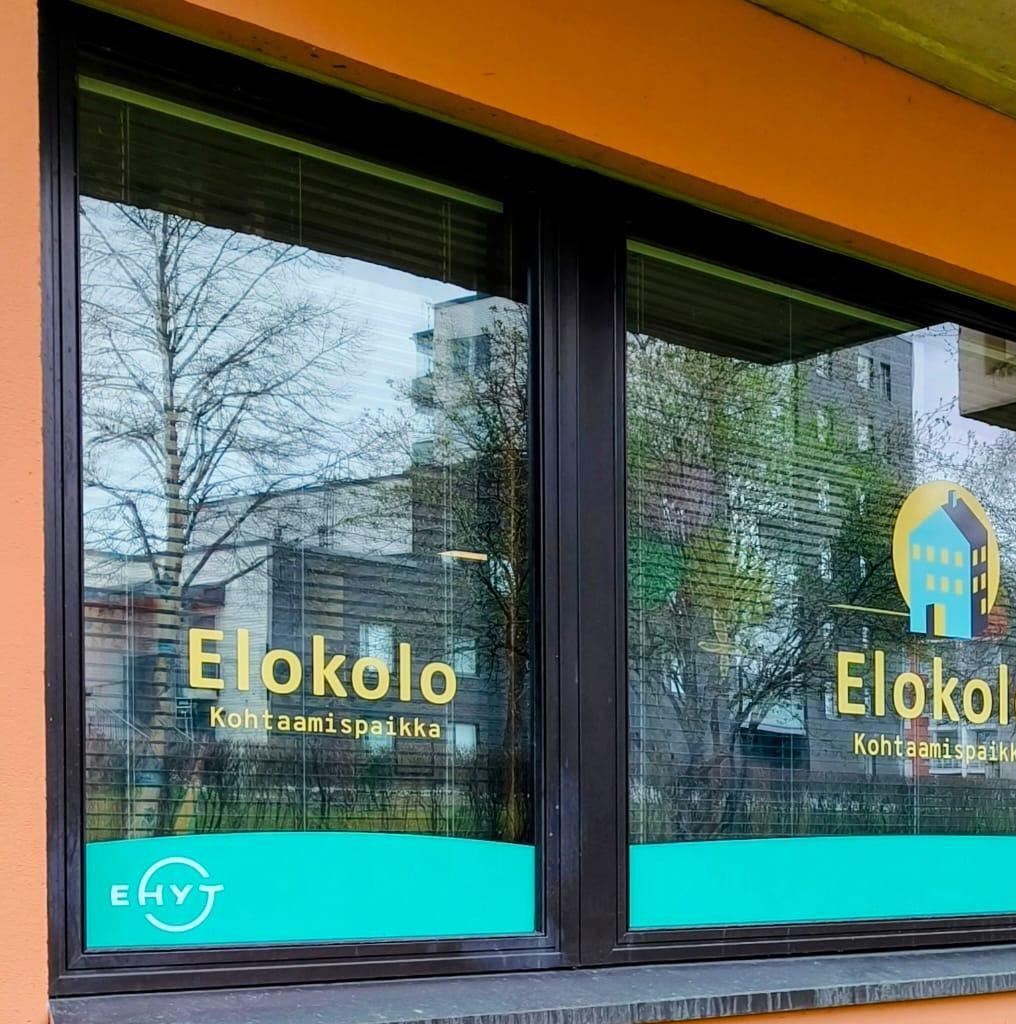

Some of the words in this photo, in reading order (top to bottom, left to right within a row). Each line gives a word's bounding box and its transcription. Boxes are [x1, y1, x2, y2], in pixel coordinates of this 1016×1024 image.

[187, 627, 458, 705] Elokolo
[210, 706, 441, 739] Kohtaamispaikka
[110, 878, 224, 916] EHYT
